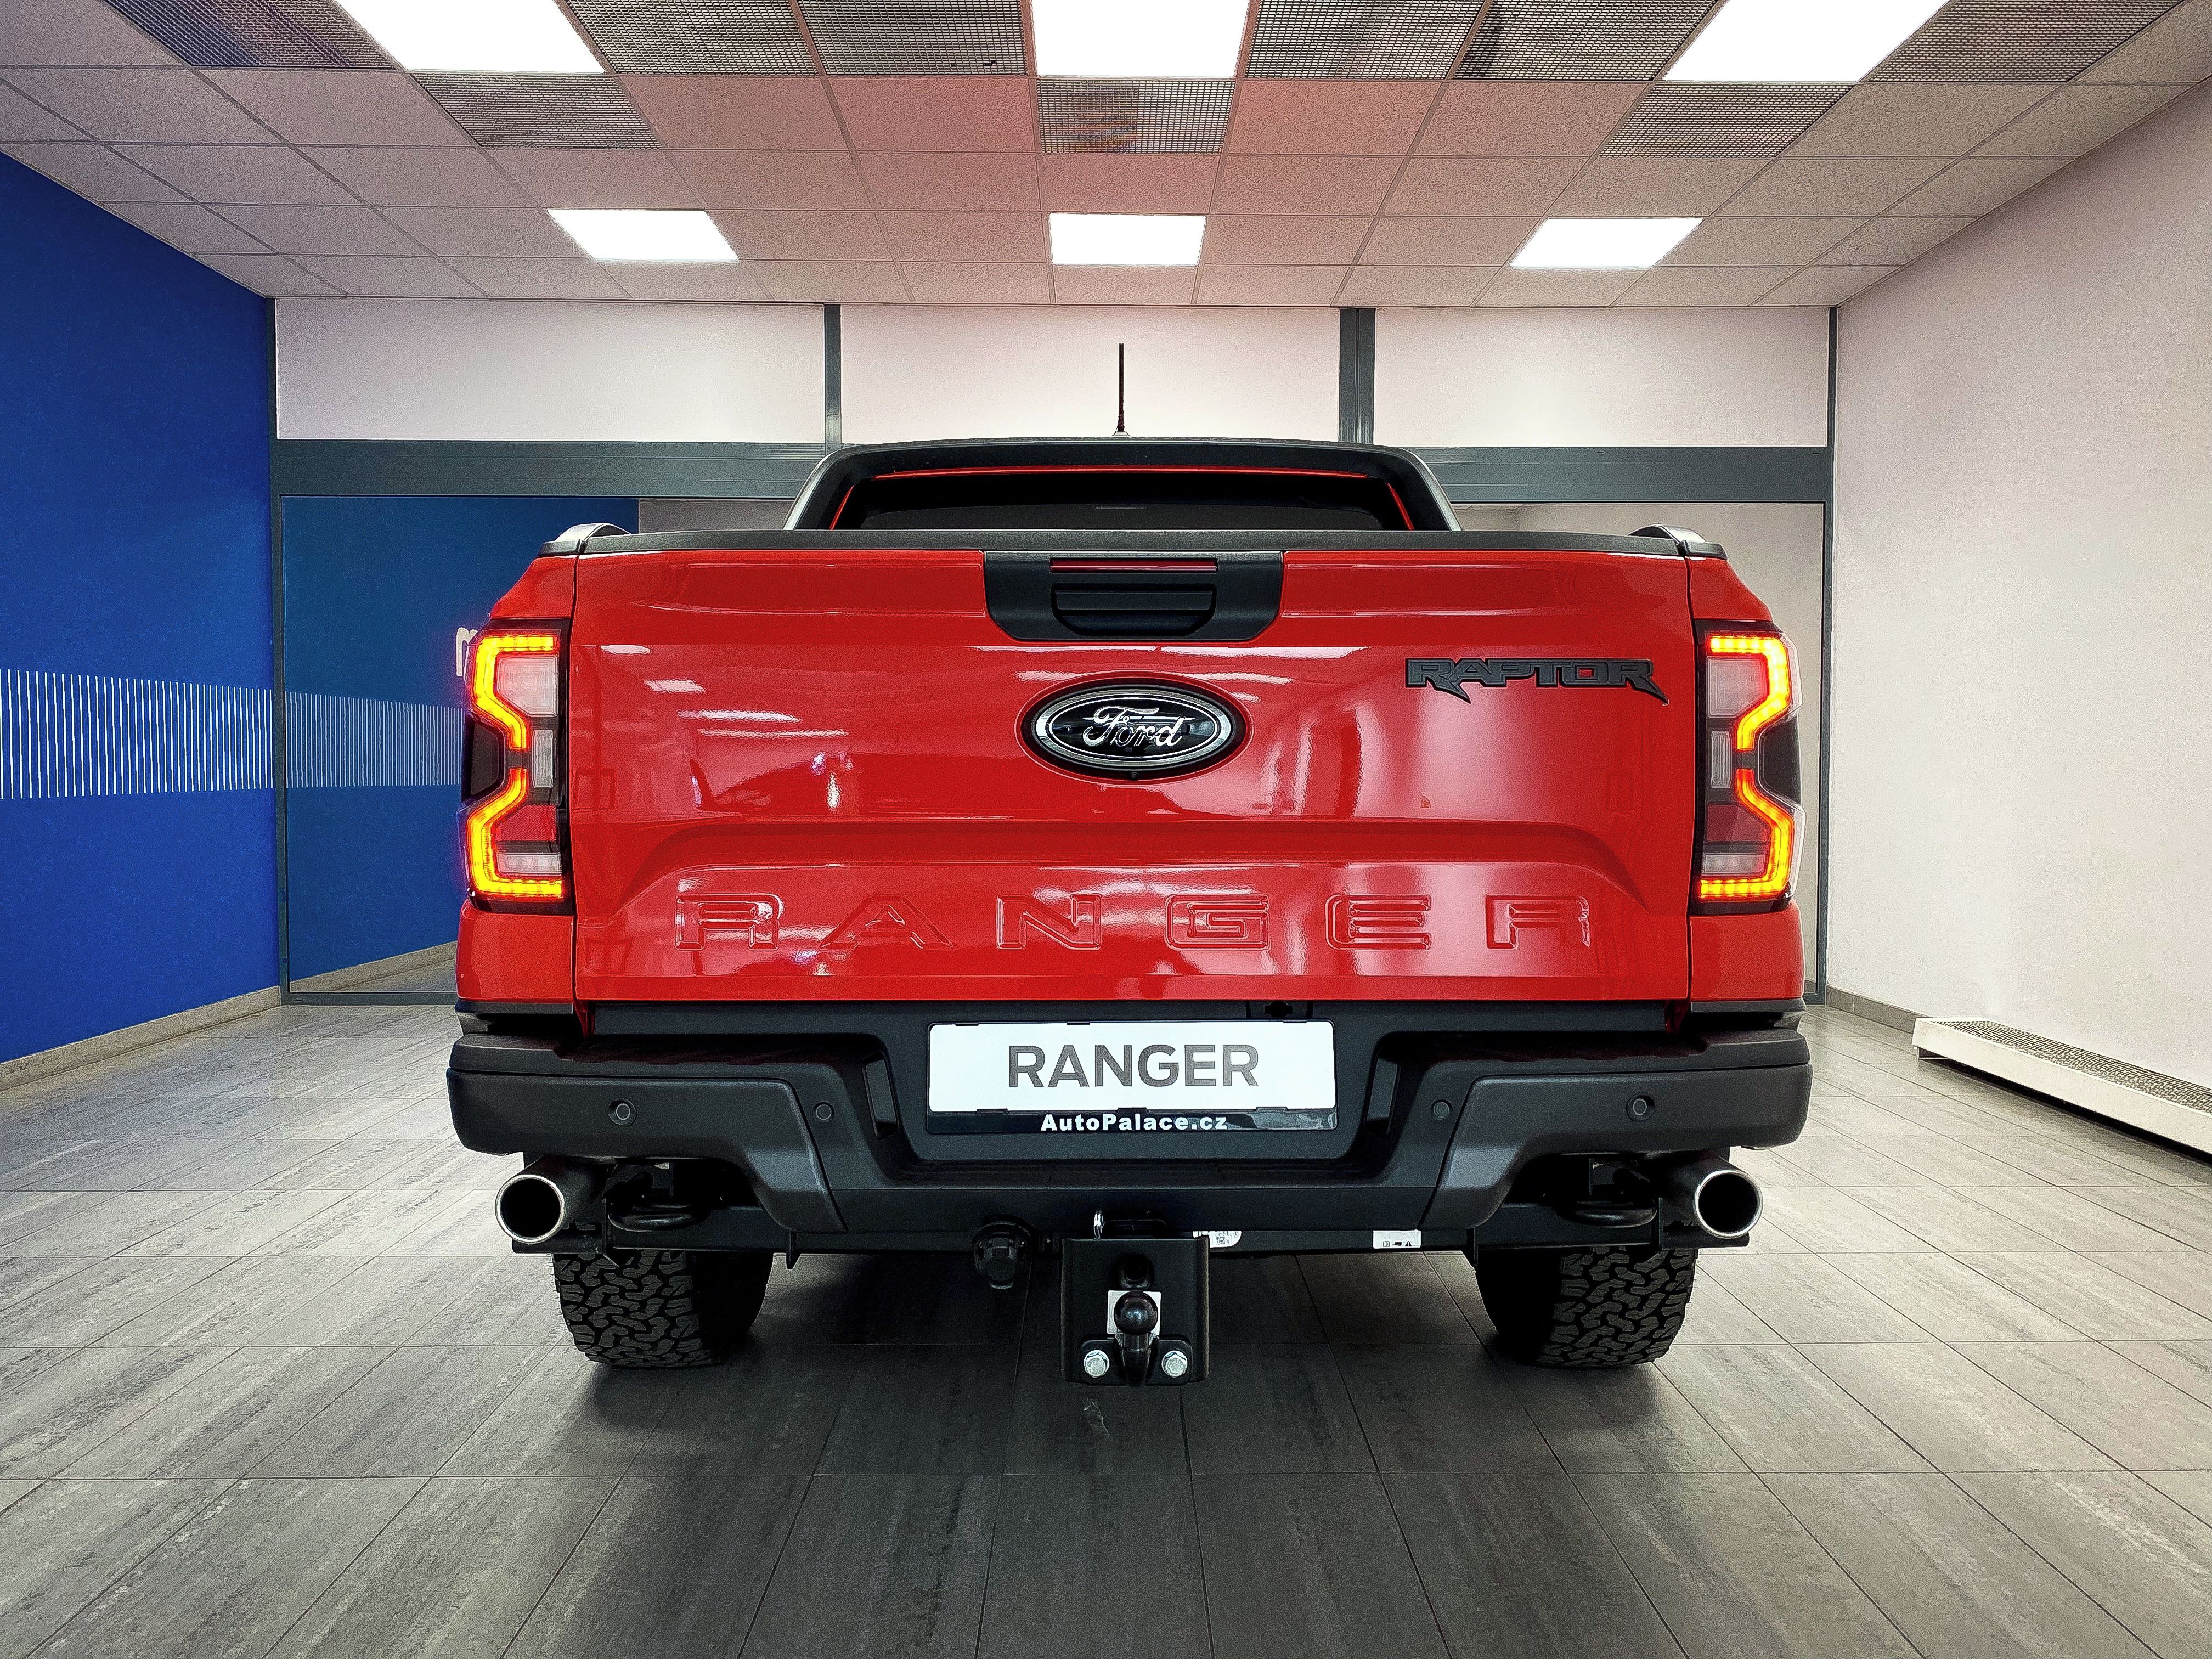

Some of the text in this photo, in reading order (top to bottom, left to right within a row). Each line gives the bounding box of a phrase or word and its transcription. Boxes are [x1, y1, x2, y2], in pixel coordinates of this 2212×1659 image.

[1406, 658, 1669, 704] RAPTOR
[1082, 705, 1186, 747] Ford
[675, 893, 1591, 951] RANGER
[1007, 1044, 1260, 1088] RANGER
[1040, 1114, 1228, 1131] AutoPalace.cz
